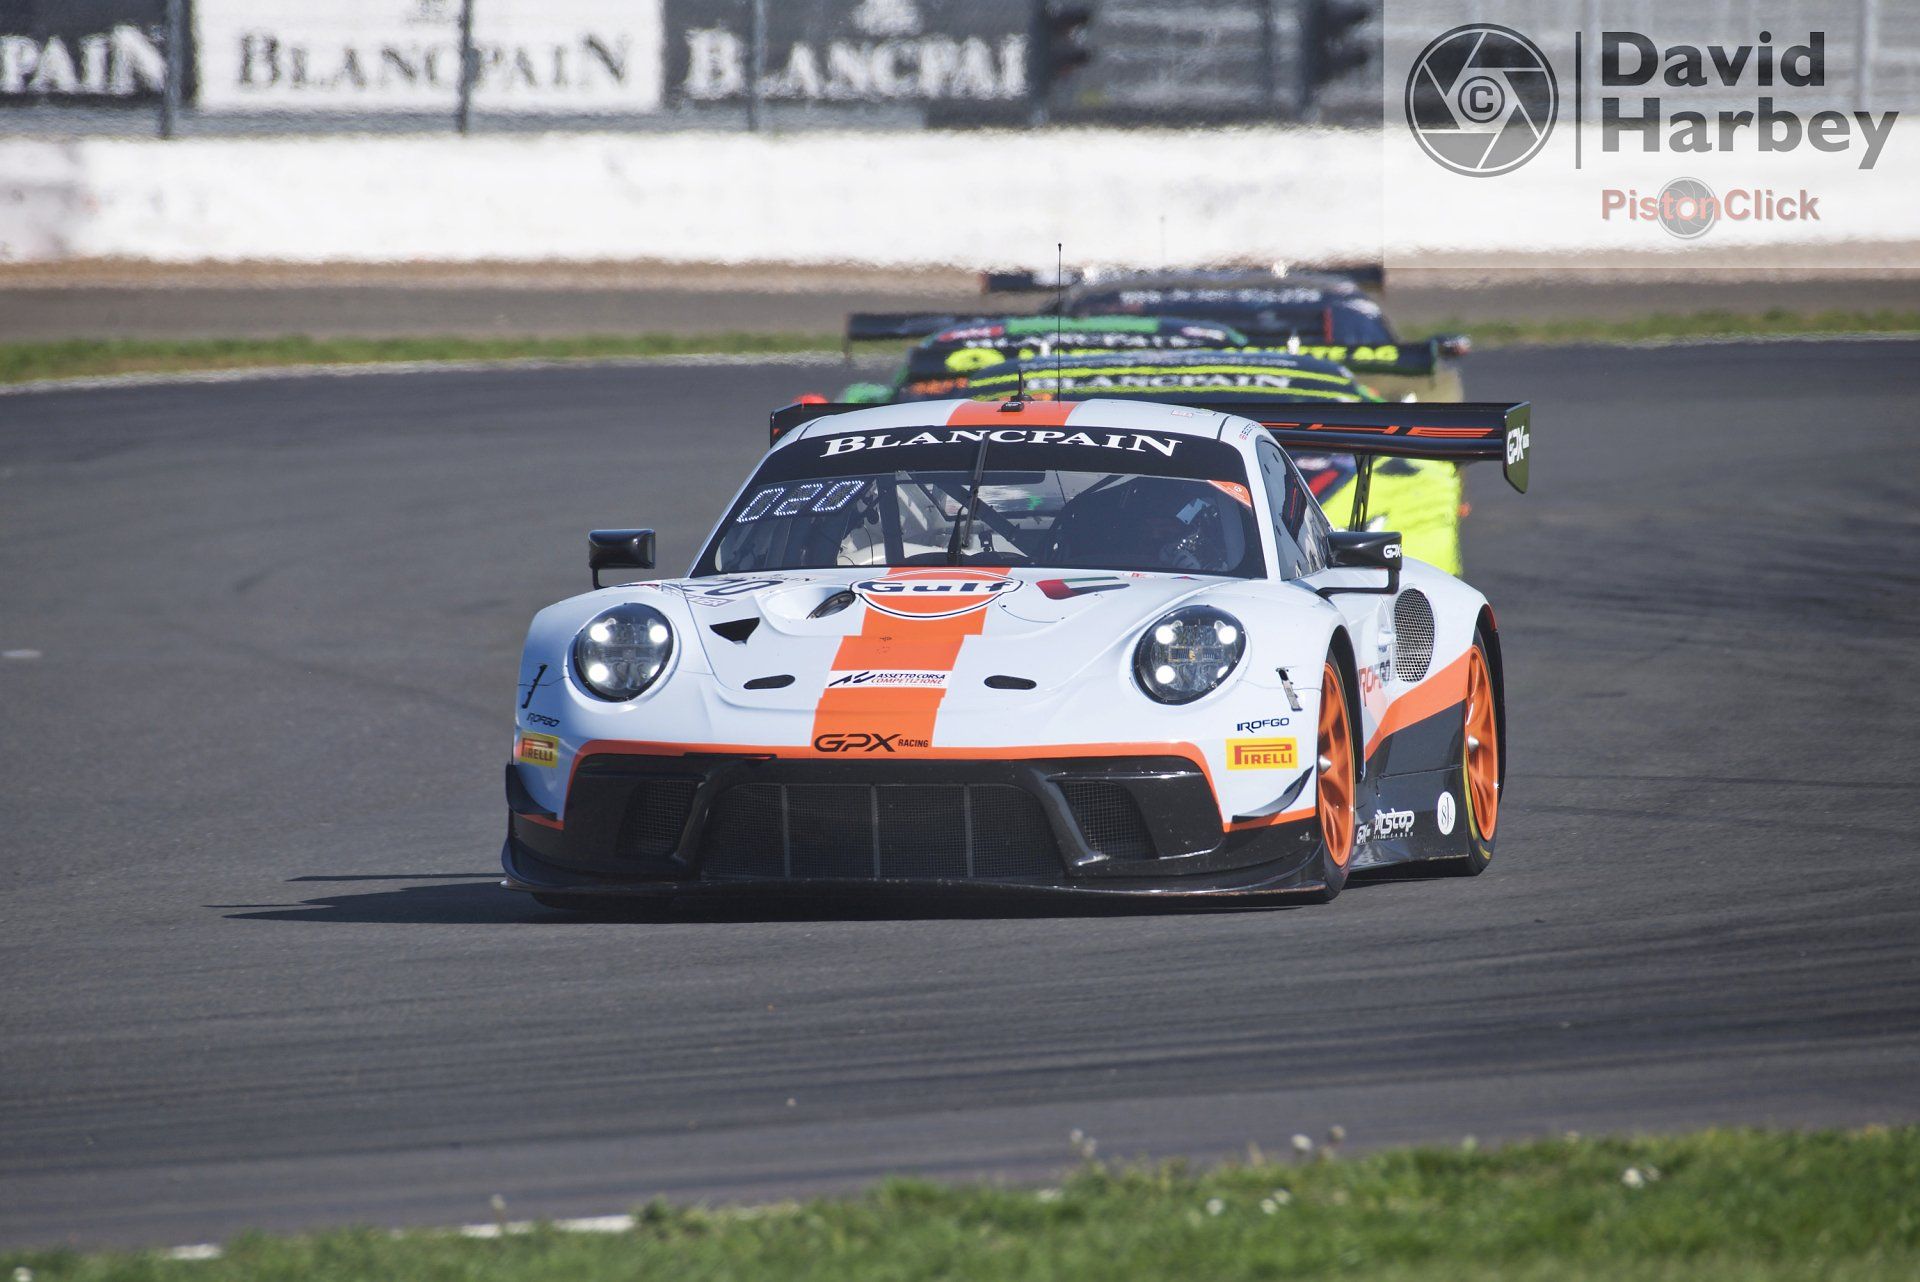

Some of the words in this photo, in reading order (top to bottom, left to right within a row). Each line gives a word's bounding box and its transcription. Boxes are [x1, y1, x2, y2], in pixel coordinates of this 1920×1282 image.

[0, 24, 168, 95] PAIN
[820, 430, 1182, 457] BLANCPAIN
[736, 480, 865, 523] 020
[857, 580, 1014, 593] Gulf
[814, 733, 902, 752] GPX
[898, 738, 929, 748] RACING
[1234, 743, 1293, 765] PIRELLI
